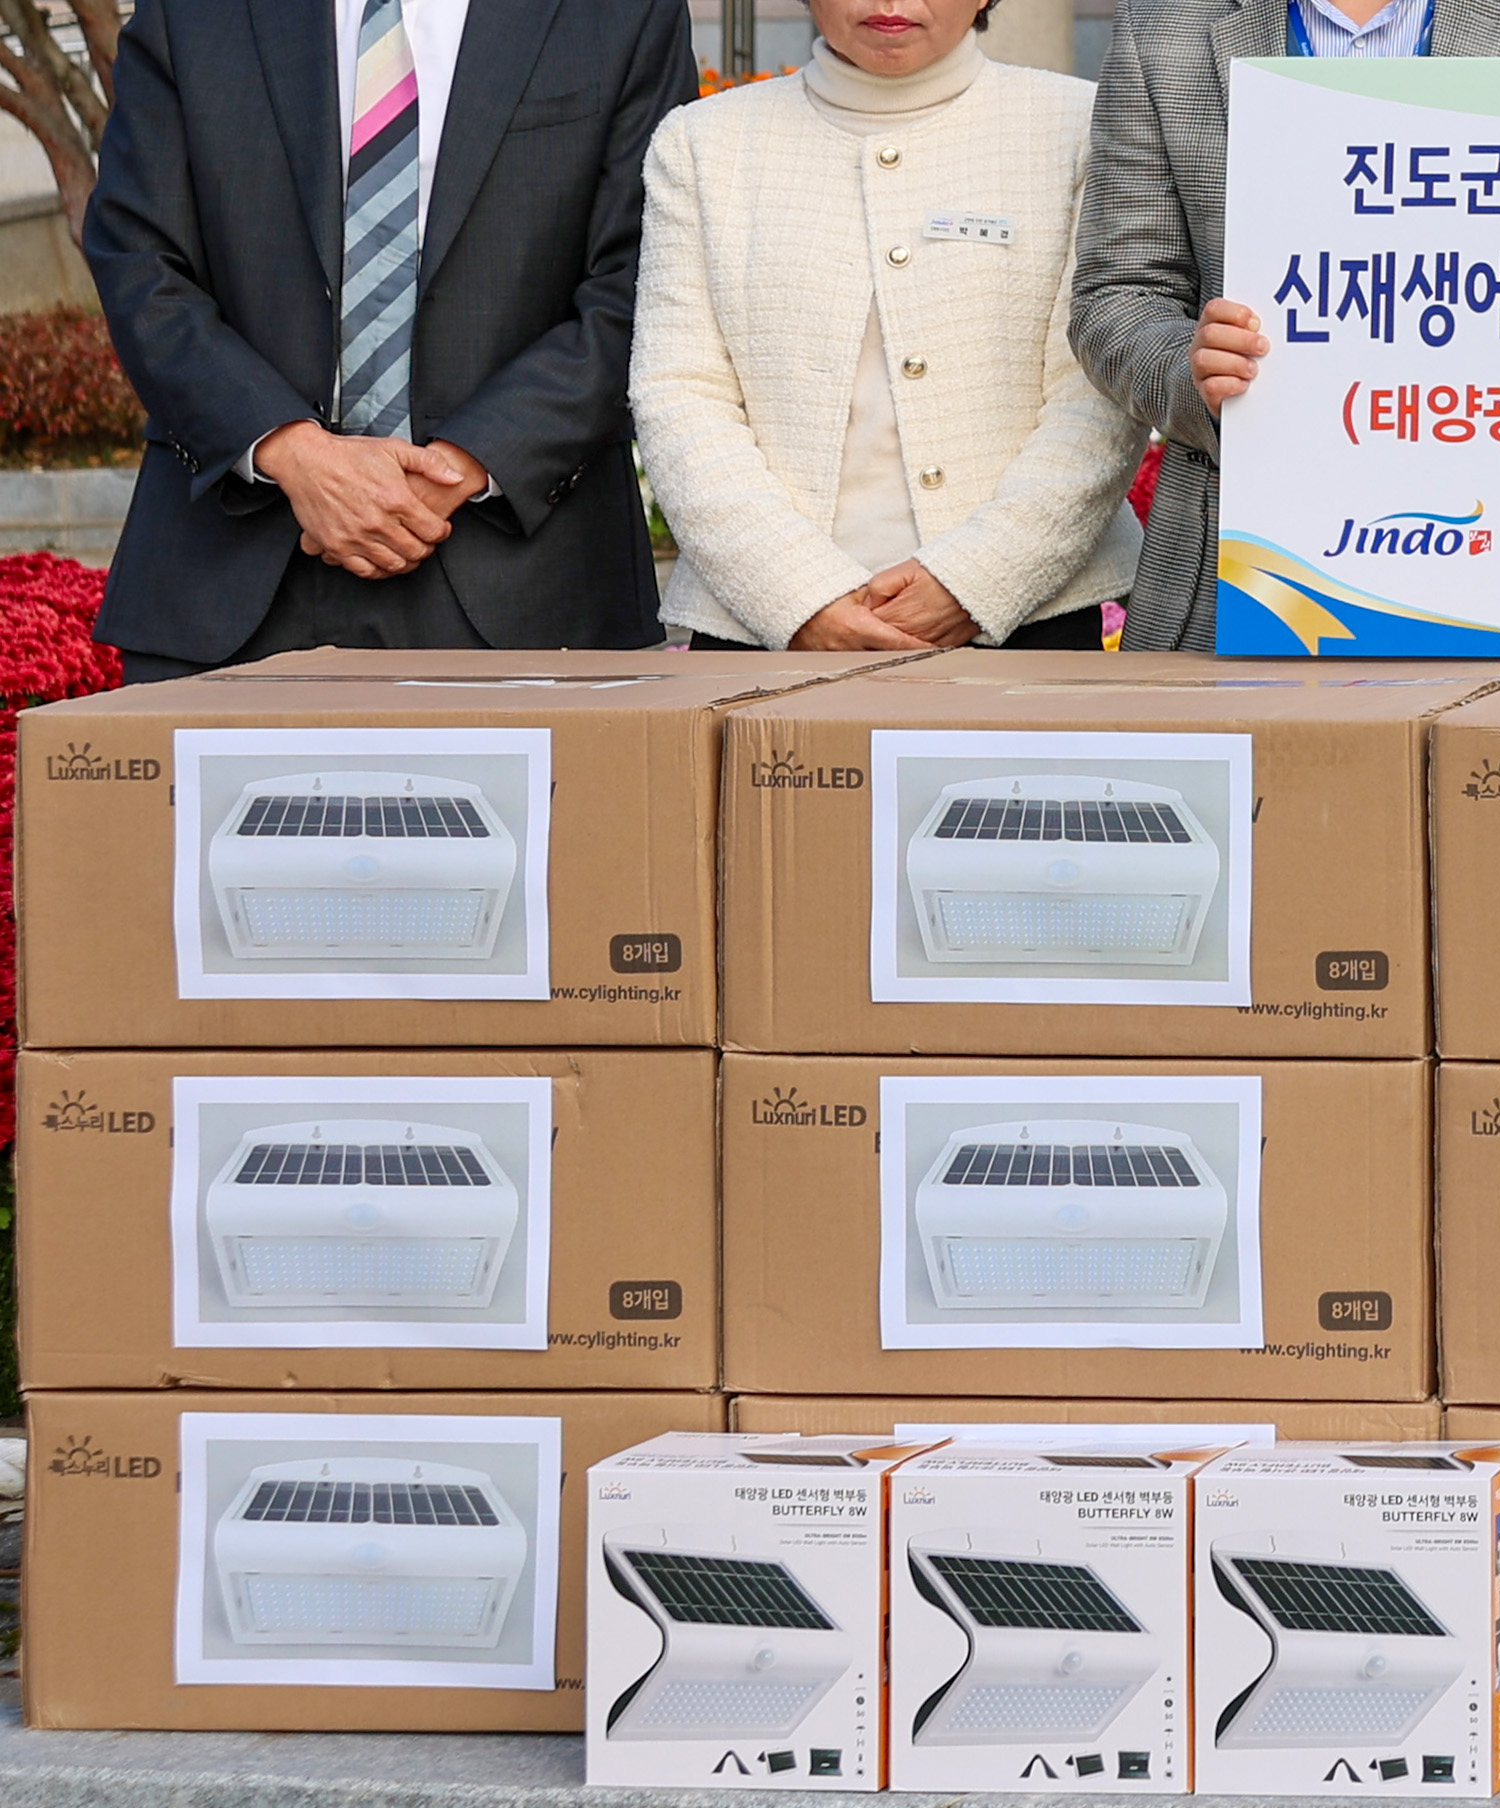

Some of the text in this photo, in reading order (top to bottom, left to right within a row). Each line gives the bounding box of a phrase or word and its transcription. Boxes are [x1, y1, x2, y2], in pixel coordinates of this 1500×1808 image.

[1323, 518, 1464, 558] Jindo
[115, 759, 161, 781] LED
[817, 768, 863, 790] LED
[622, 941, 670, 963] 8개입
[1329, 959, 1377, 982] 8개입
[551, 986, 681, 1004] ww.cylighting.kr
[108, 1112, 156, 1134] LED
[820, 1105, 867, 1128] LED
[622, 1289, 670, 1311] 8개입
[1331, 1299, 1380, 1322] 8개입
[547, 1331, 681, 1350] ww.cylighting.kr
[114, 1456, 161, 1479] LED
[735, 1488, 867, 1503] 태양광 LED 센서형 벽부등
[1040, 1491, 1173, 1504] 태양광 LED 센서형 벽부등
[1344, 1494, 1478, 1508] 태양광 LED 센서형 벽부등
[772, 1505, 867, 1517] BUTTERFLY 8W
[1078, 1508, 1174, 1519] BUTTERFLY 8W
[1382, 1512, 1479, 1522] BUTTERFLY 8W
